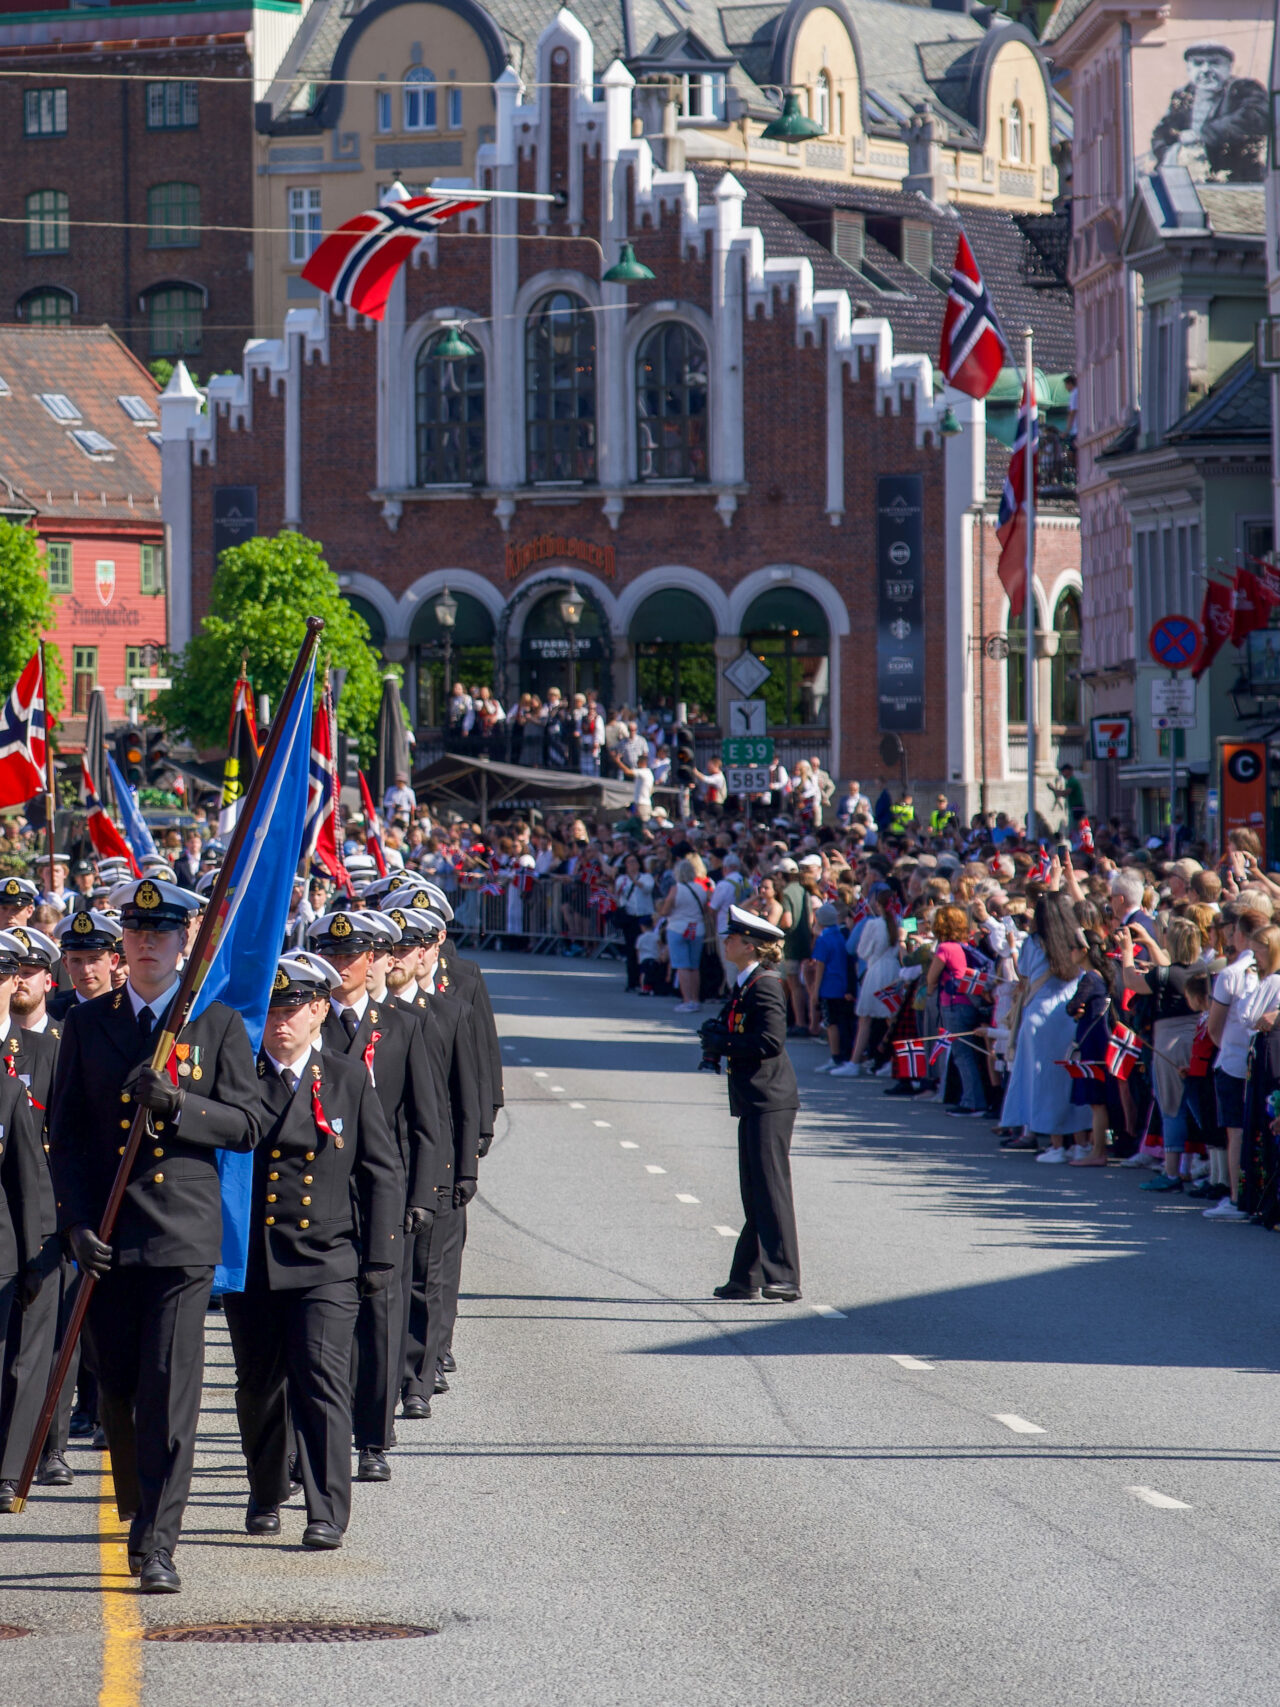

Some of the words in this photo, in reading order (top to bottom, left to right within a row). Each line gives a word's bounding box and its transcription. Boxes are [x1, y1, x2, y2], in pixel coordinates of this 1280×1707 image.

[530, 640, 591, 650] STARBUKS
[729, 743, 739, 760] E
[744, 743, 767, 760] 39
[1236, 755, 1255, 777] C
[732, 773, 766, 788] 585
